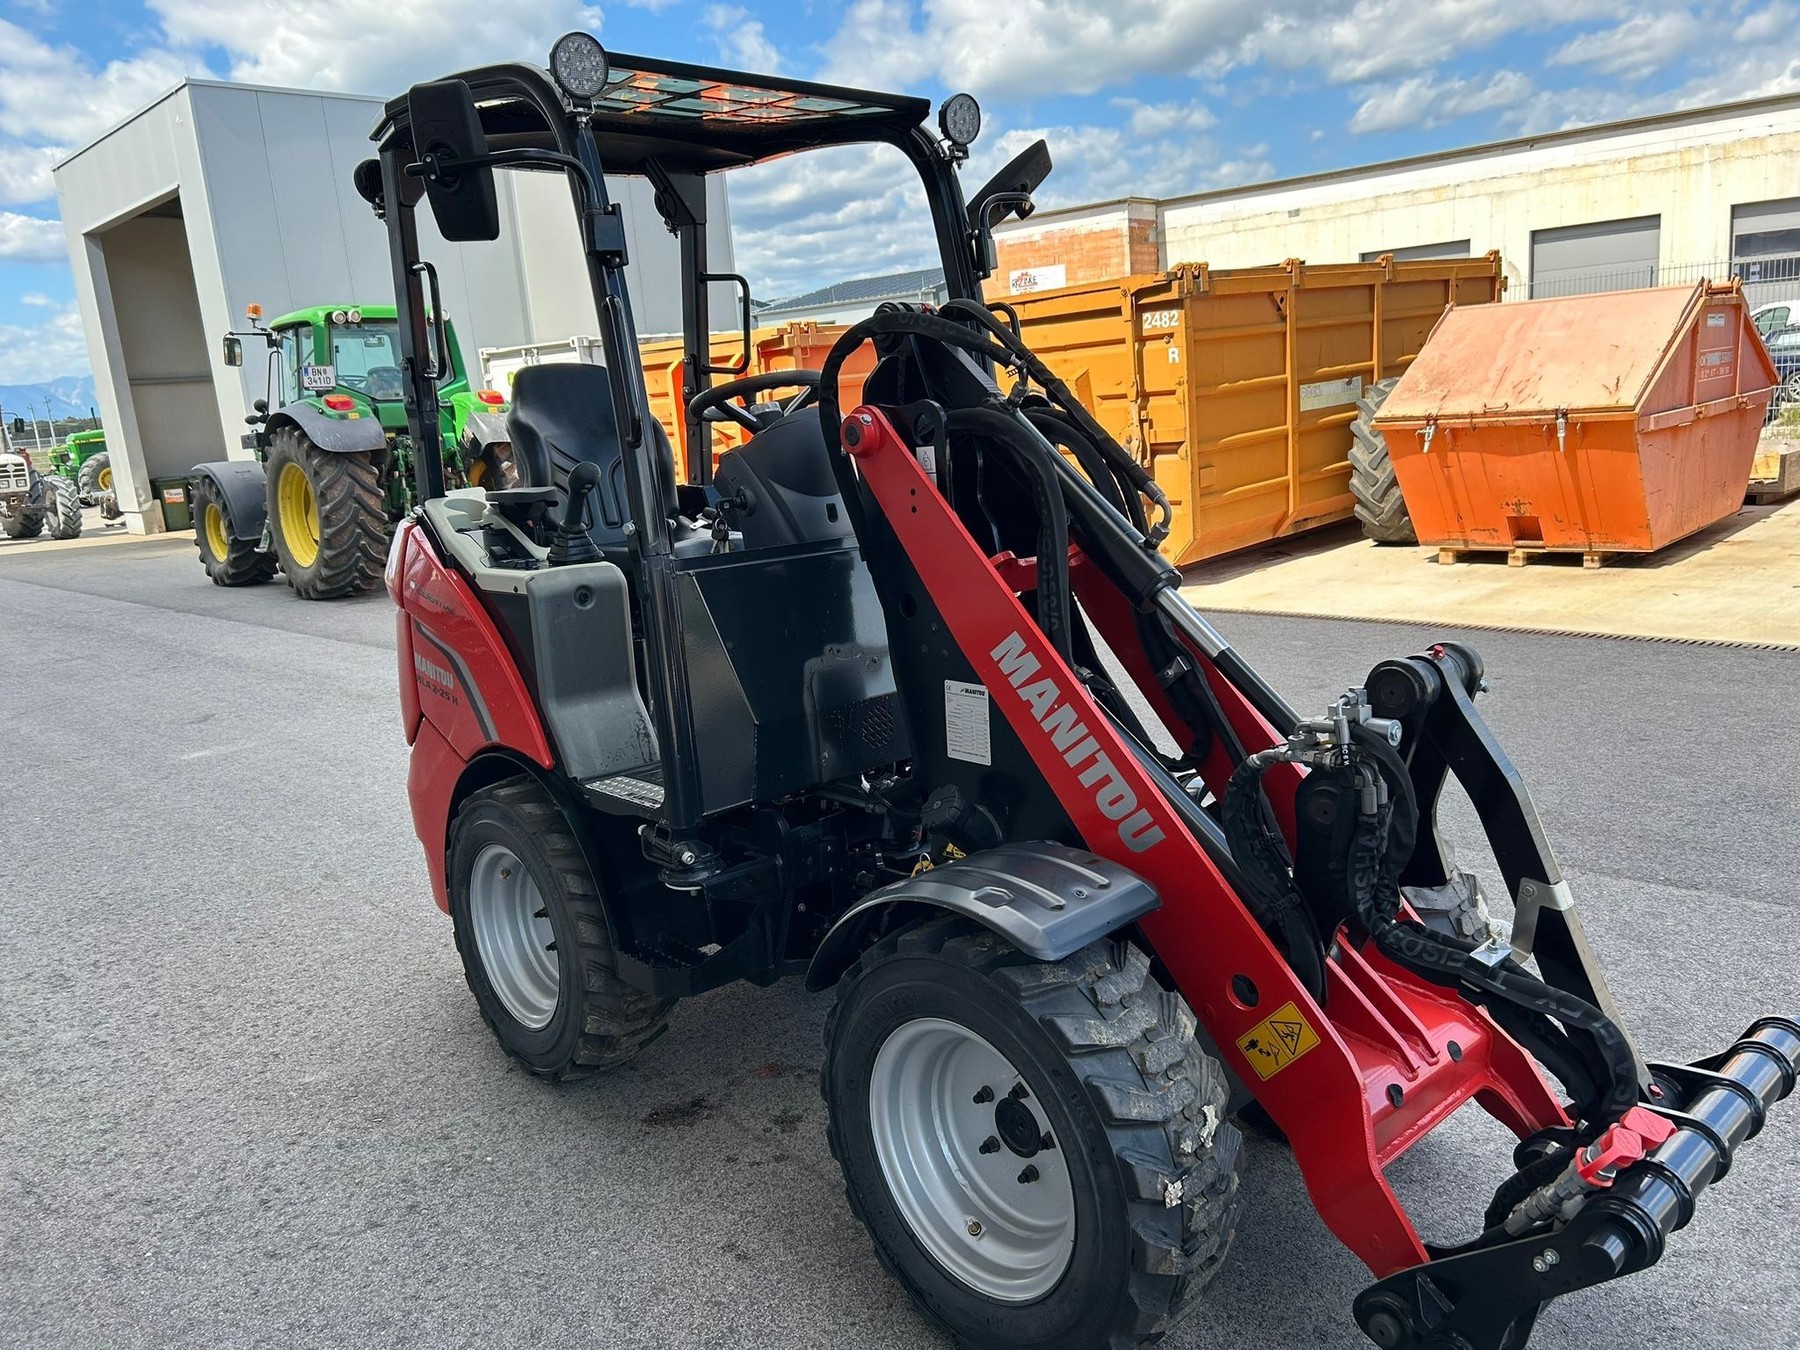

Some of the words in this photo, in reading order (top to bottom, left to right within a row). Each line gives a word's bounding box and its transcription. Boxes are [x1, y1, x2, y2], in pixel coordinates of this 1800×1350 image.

[1143, 310, 1179, 329] 2482
[1168, 347, 1180, 364] R
[311, 367, 327, 376] BN
[415, 652, 454, 690] MANITOU
[964, 687, 986, 697] MANITOU
[988, 630, 1166, 853] MANITOU
